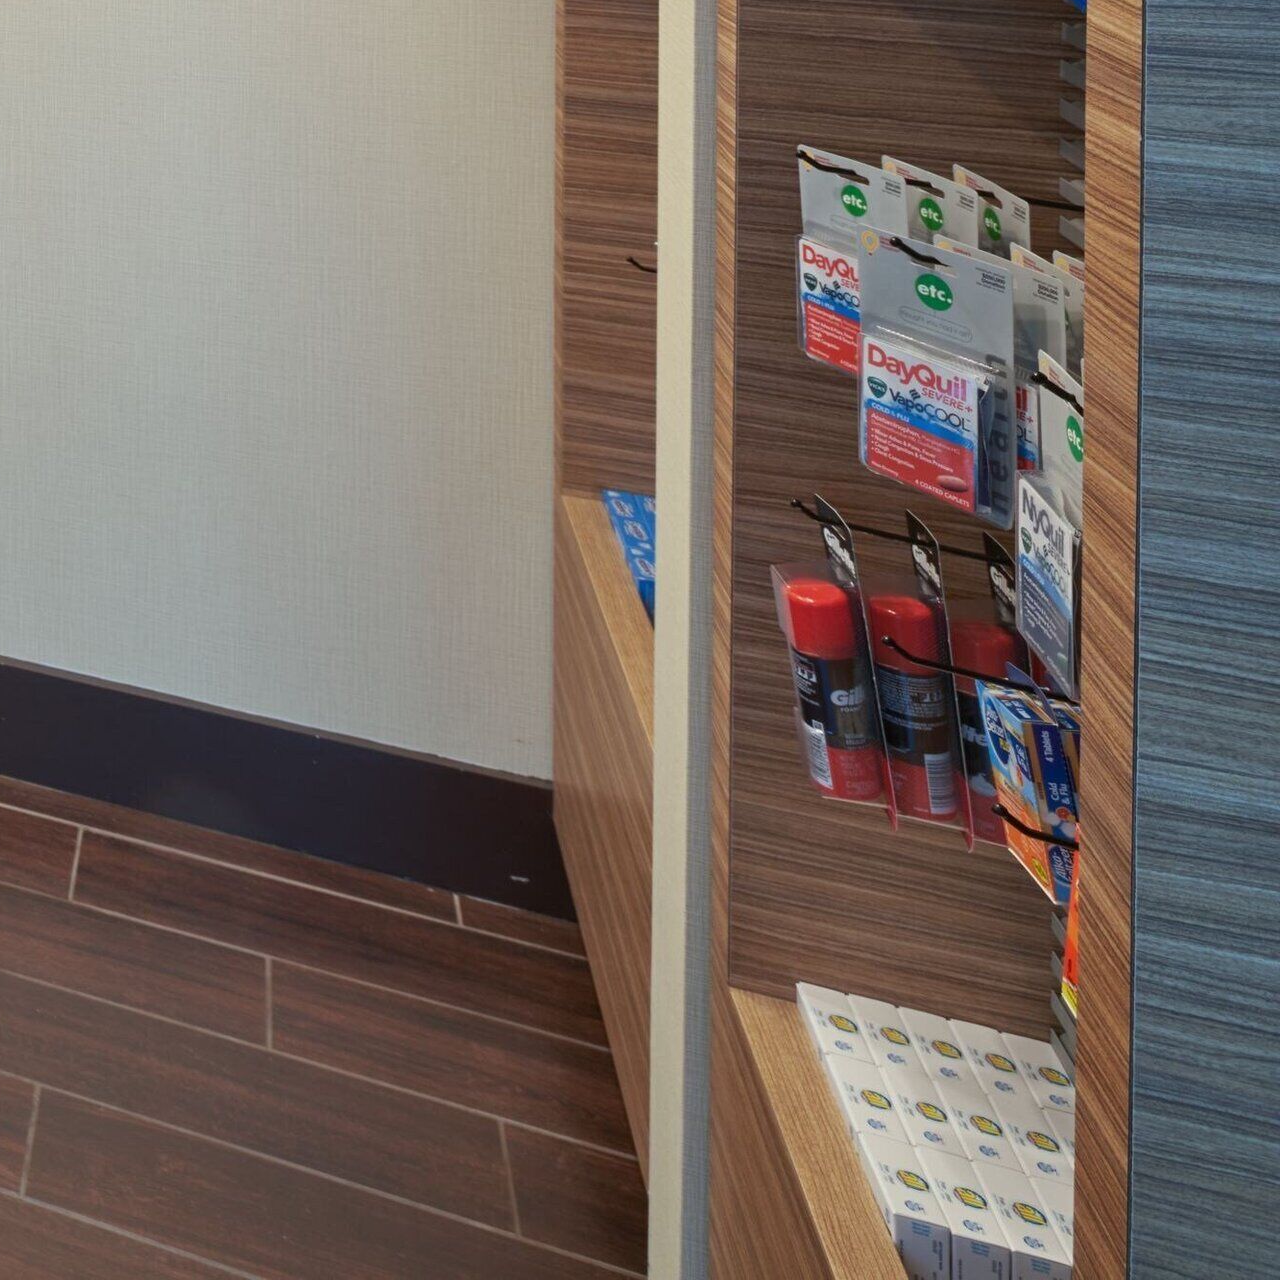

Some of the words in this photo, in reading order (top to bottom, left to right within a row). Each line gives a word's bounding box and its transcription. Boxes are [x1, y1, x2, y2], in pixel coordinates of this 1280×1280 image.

[841, 192, 868, 211] etc.
[920, 206, 944, 223] etc.
[985, 216, 1001, 233] etc.
[917, 283, 953, 304] etc.
[868, 343, 967, 402] DayQuil
[920, 481, 944, 496] COATED
[945, 491, 971, 508] CAPLETS
[1022, 486, 1065, 559] NyQuil
[1044, 730, 1055, 756] Tablets
[1051, 782, 1060, 802] Cold
[1059, 783, 1069, 797] Flu
